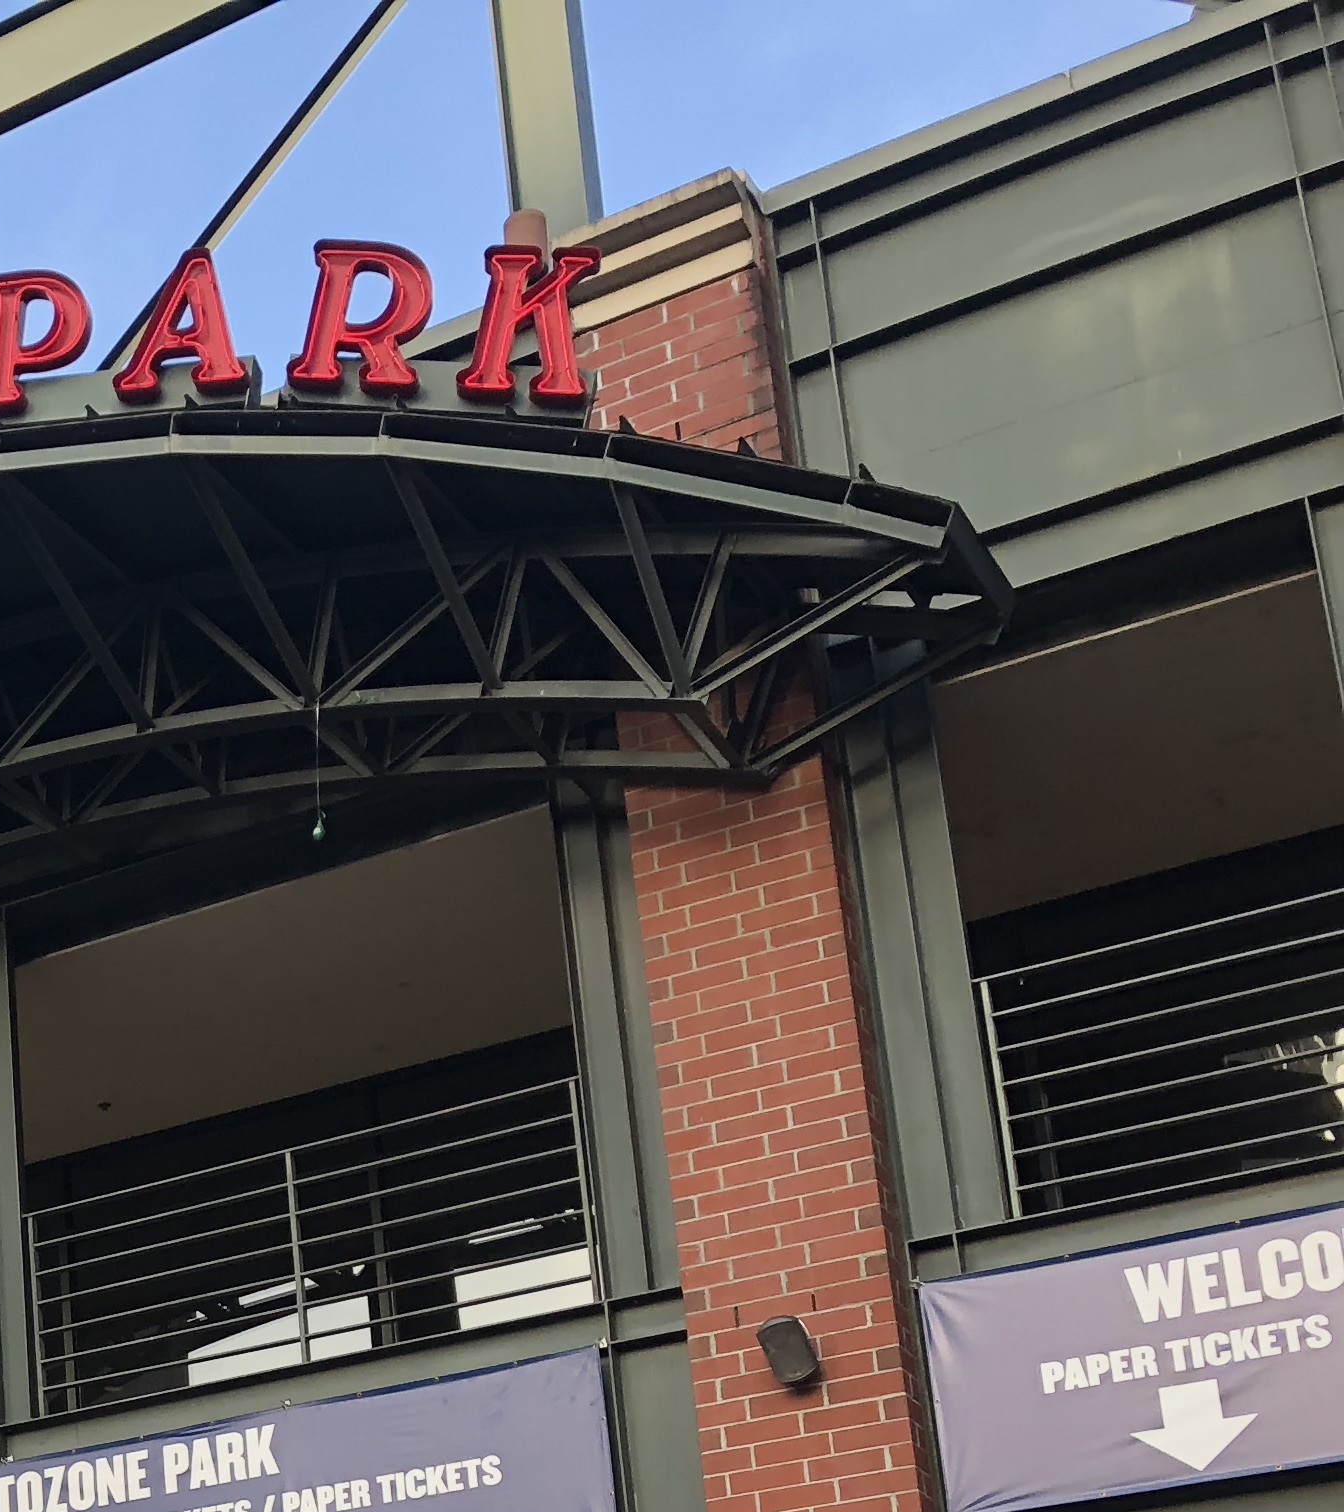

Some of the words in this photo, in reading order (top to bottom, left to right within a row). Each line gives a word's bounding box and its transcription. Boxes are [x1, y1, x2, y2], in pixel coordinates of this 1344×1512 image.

[1124, 1226, 1344, 1324] WELCO
[1039, 1345, 1160, 1395] PAPER
[1163, 1313, 1333, 1373] TICKETS
[163, 1424, 280, 1495] PARK
[375, 1455, 504, 1504] TICKETS
